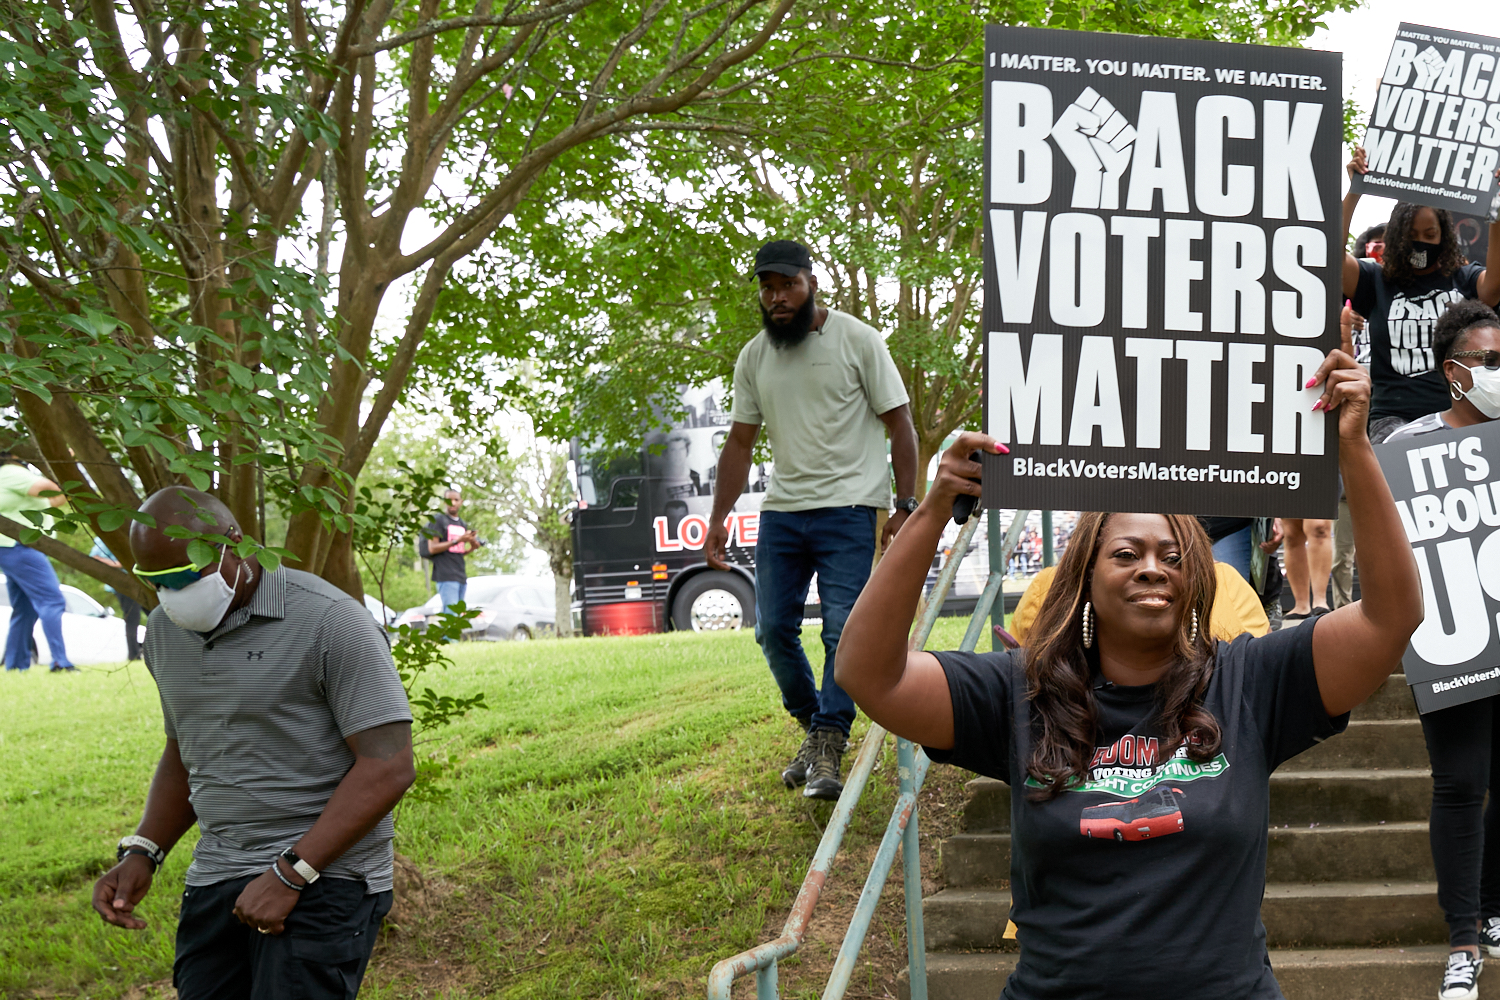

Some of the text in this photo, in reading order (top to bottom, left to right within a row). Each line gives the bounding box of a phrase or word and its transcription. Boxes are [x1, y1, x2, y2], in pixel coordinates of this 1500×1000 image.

[1433, 35, 1450, 45] YOU
[1482, 43, 1495, 53] WE
[990, 52, 1327, 91] I MATTER. YOU MATTER. WE MATTER.
[990, 80, 1326, 222] BACK
[1364, 127, 1499, 192] MATTER
[1363, 174, 1478, 204] BlackVotersMatterFund.org
[989, 209, 1328, 340] VOTERS
[987, 330, 1327, 456] MATTER
[1013, 456, 1301, 490] BlackVotersMatterFund.org
[1406, 436, 1491, 493] IT'S
[1093, 766, 1153, 781] VOTING
